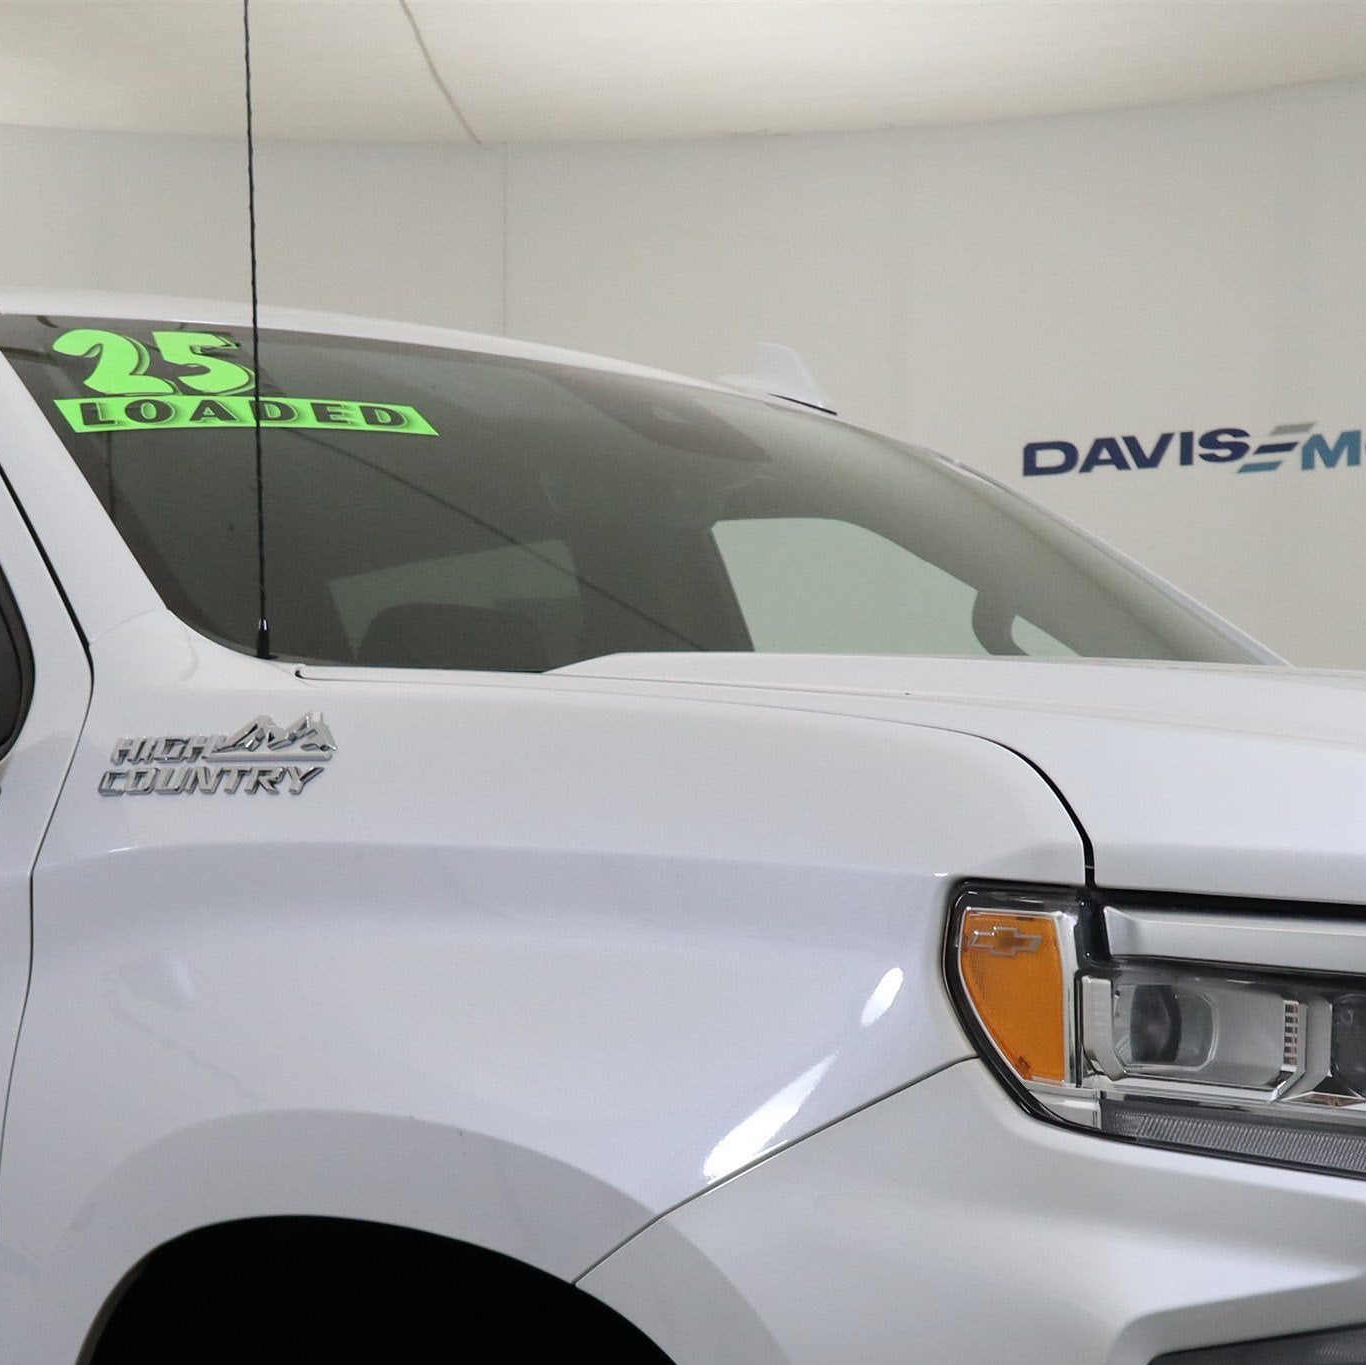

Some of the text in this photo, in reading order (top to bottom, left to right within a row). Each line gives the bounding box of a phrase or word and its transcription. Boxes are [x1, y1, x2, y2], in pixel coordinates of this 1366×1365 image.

[52, 328, 256, 396] 25
[79, 399, 409, 427] LOADED
[1022, 428, 1251, 477] DAVIS
[111, 735, 227, 764] HIGH
[98, 766, 325, 795] COUNTRY
